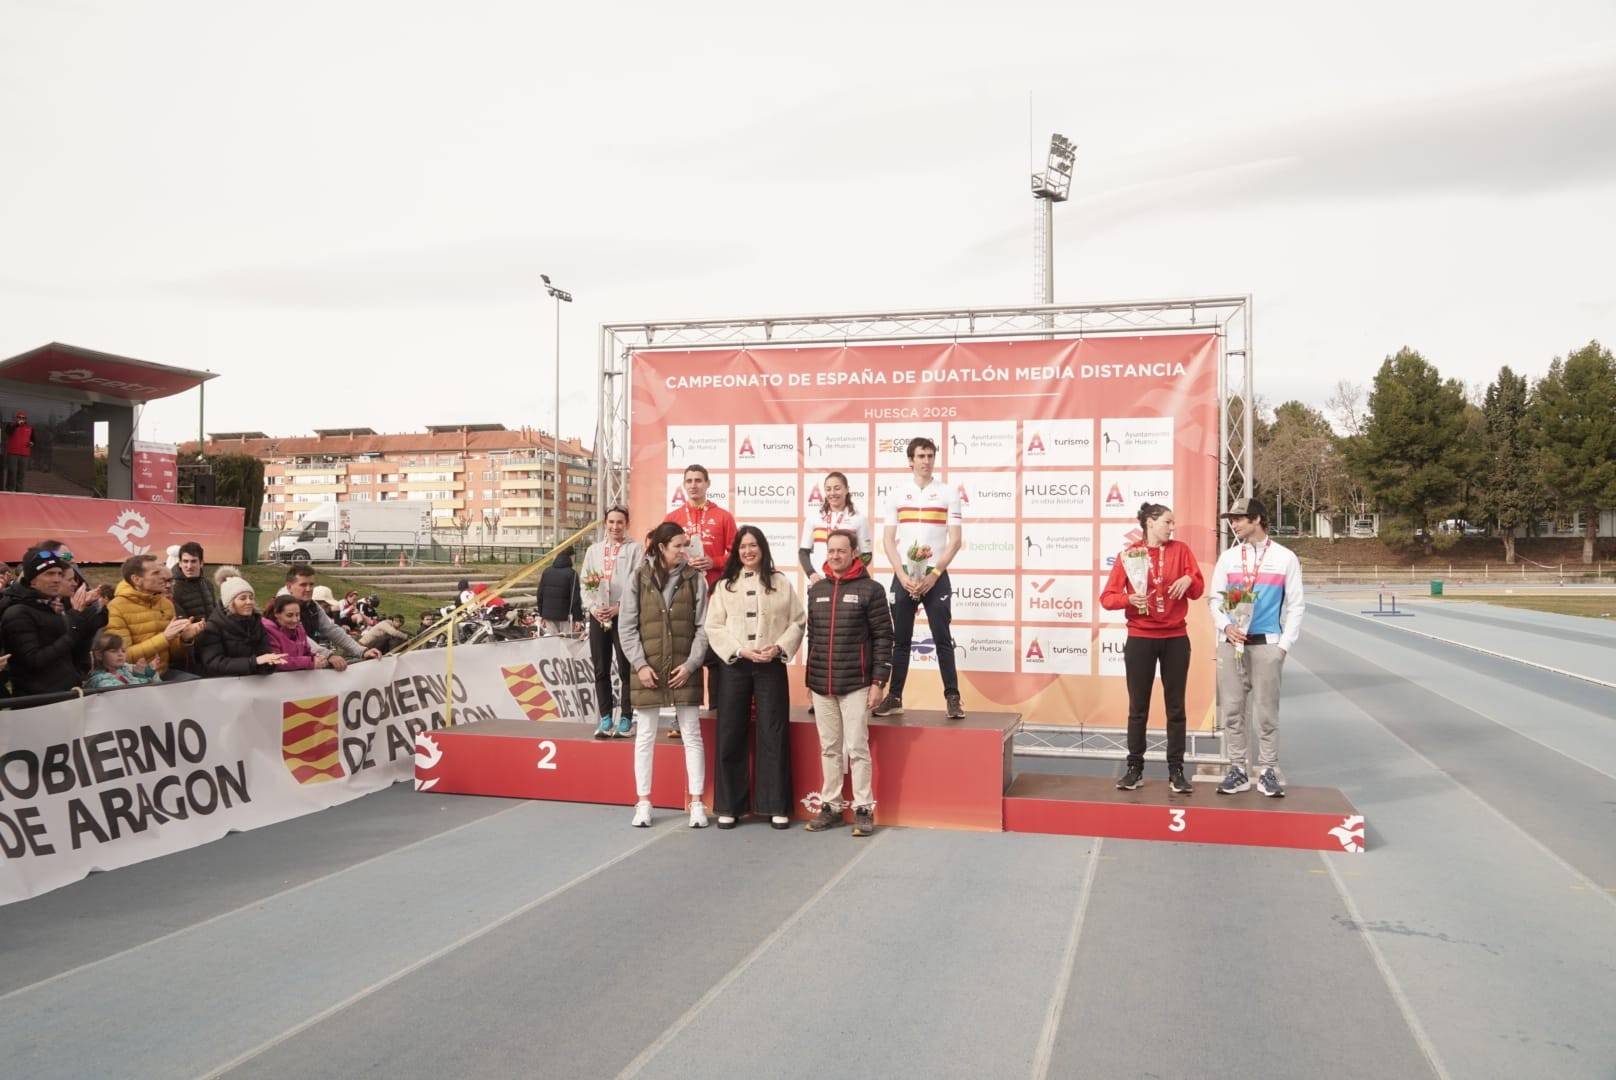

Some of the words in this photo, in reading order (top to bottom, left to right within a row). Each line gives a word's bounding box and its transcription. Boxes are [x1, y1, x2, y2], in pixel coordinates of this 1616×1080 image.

[666, 373, 784, 389] CAMPEONATO
[788, 373, 811, 387] DE
[816, 368, 886, 386] ESPAÑA
[892, 371, 916, 384] DE
[921, 365, 1009, 383] DUATLÓN
[1015, 366, 1074, 381] MEDIA
[1080, 362, 1186, 379] DISTANCIA
[864, 408, 919, 419] HUESCA
[923, 406, 957, 418] 2026
[763, 442, 794, 450] turismo
[1054, 438, 1090, 446] turismo
[893, 445, 904, 453] DE
[737, 486, 796, 497] HUESCA
[978, 490, 1012, 498] turismo
[1024, 484, 1091, 496] HUESCA
[1133, 488, 1169, 497] turismo
[706, 491, 726, 499] ismo
[1055, 541, 1079, 550] Huesca
[951, 587, 1014, 599] HUESCA
[1029, 596, 1084, 610] Halcón
[1057, 610, 1083, 619] viajes
[970, 638, 1014, 646] Ayuntamiento
[981, 645, 1002, 653] Huesca
[1053, 645, 1088, 654] turismo
[0, 718, 207, 801] OBIERNO
[536, 740, 557, 770] 2
[0, 806, 56, 859] DE
[68, 760, 252, 850] ARAGON
[1168, 809, 1186, 832] 3
